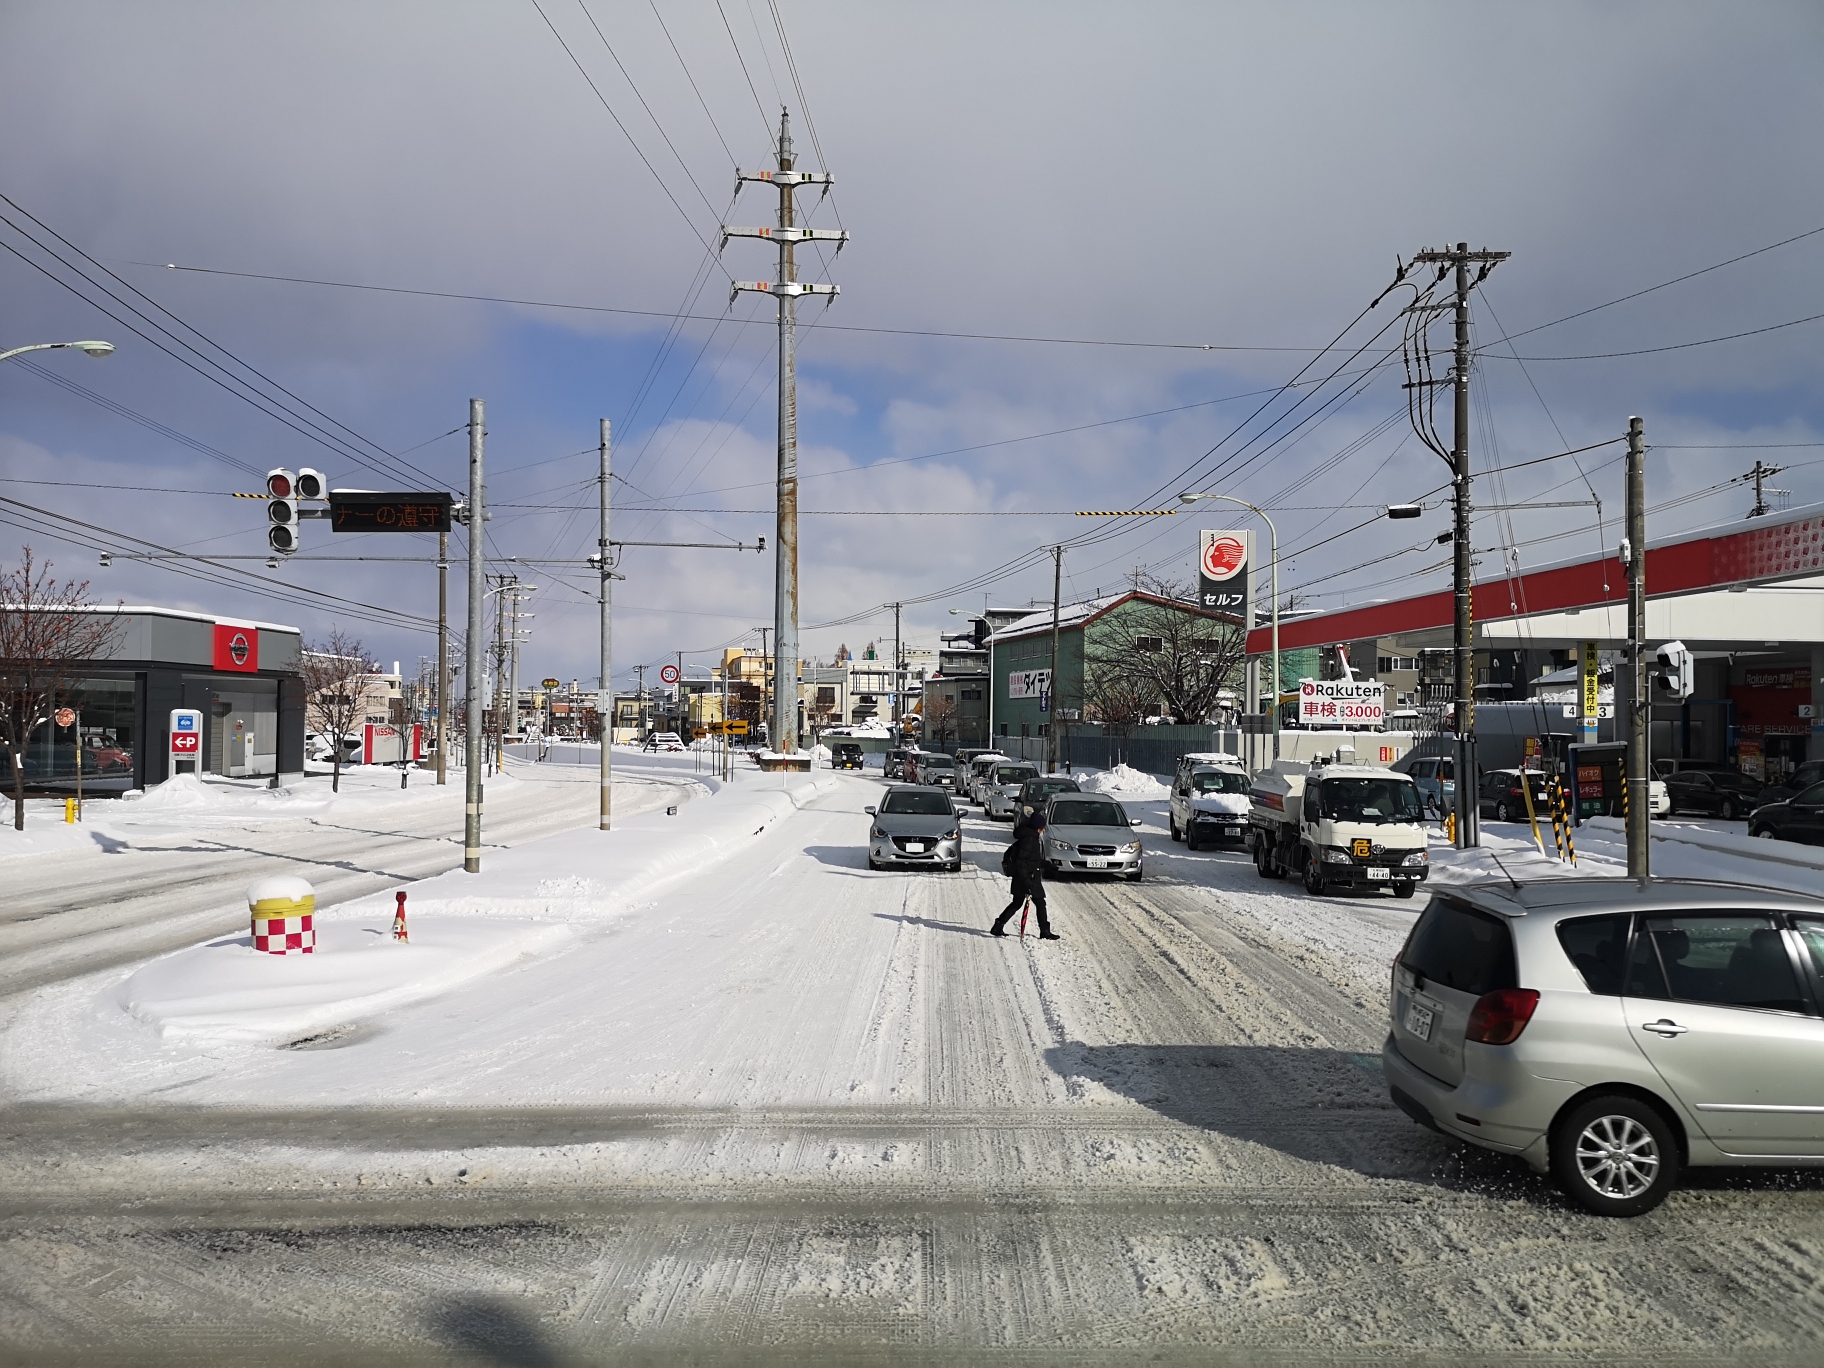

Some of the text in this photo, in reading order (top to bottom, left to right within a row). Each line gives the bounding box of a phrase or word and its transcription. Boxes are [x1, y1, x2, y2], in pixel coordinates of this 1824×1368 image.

[1203, 593, 1243, 606] セルフ
[664, 670, 676, 679] 50
[1745, 673, 1778, 685] Rakuten
[1316, 683, 1382, 697] Rakuten
[1303, 701, 1337, 718] 車検
[1345, 705, 1382, 718] 3,000
[1568, 706, 1575, 716] 4
[1598, 706, 1607, 718] 3
[1803, 706, 1811, 716] 2
[375, 727, 396, 737] NISSAN
[1740, 724, 1812, 734] ARE SERVICE
[186, 736, 196, 748] P
[1578, 769, 1600, 778] ハイオク
[1579, 785, 1602, 794] レギュラー
[1353, 839, 1371, 857] 危
